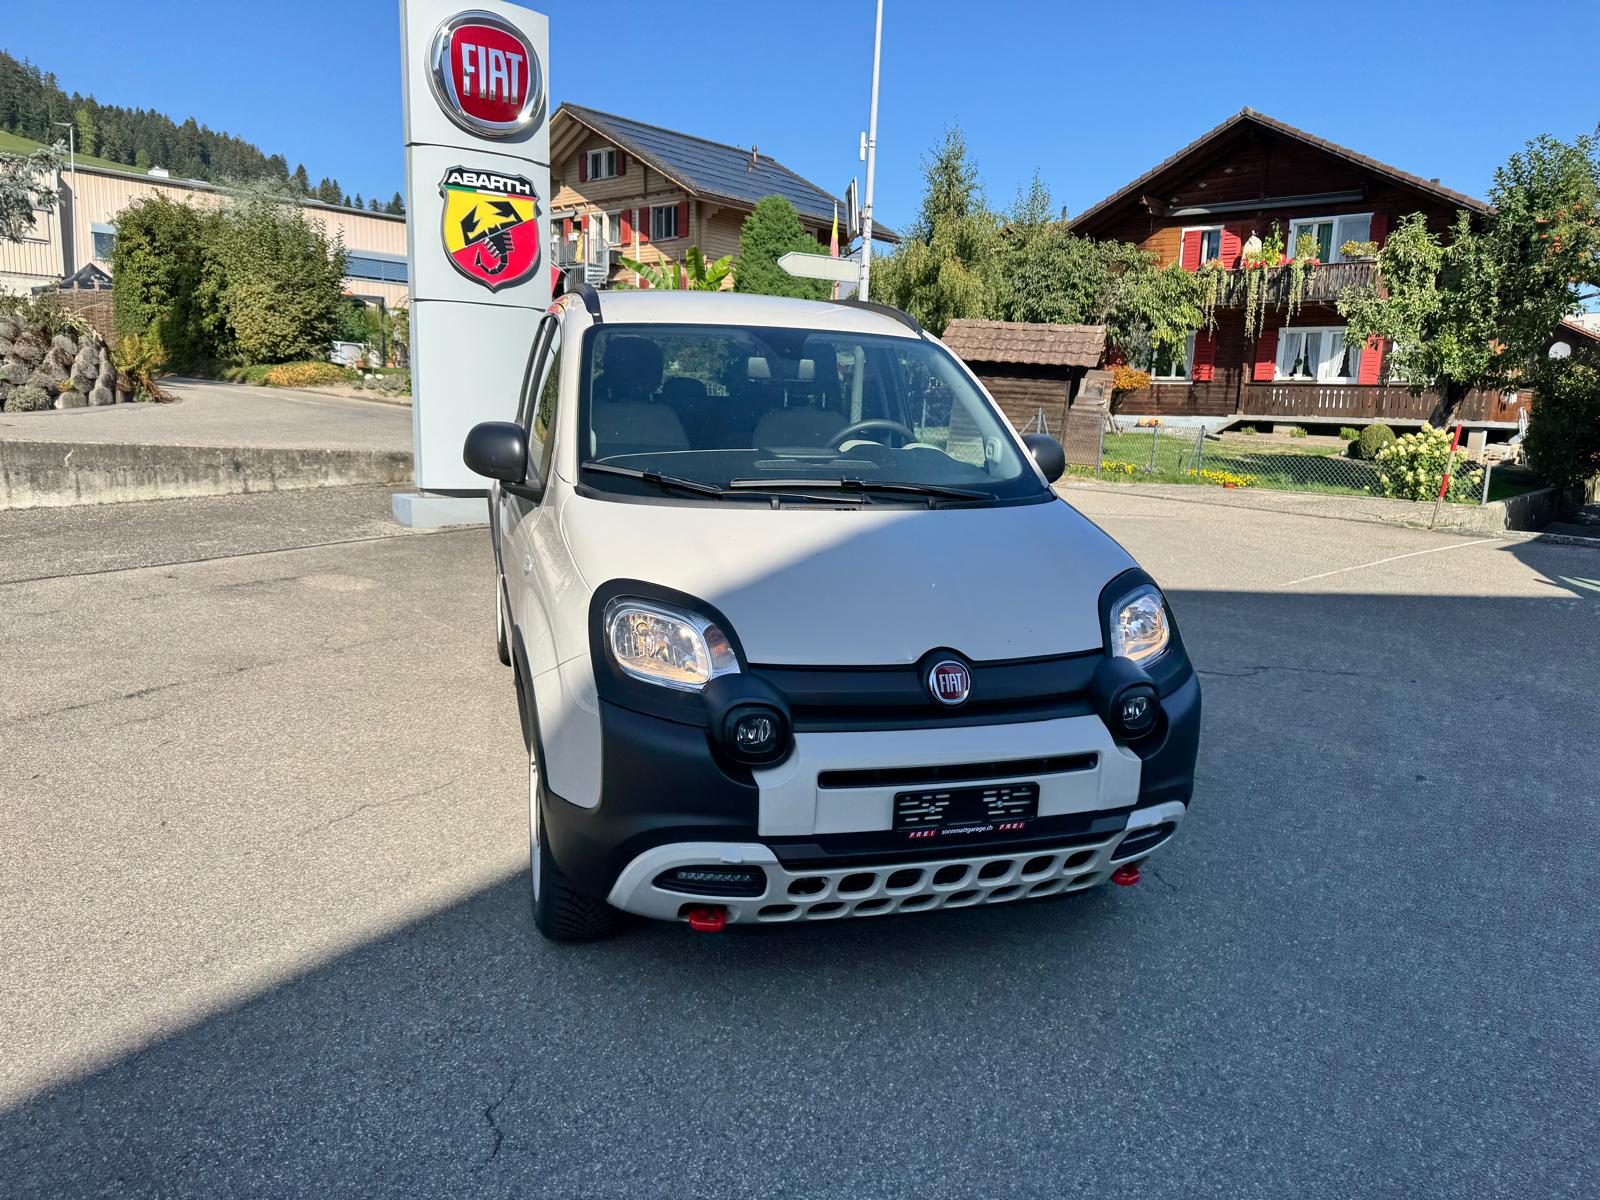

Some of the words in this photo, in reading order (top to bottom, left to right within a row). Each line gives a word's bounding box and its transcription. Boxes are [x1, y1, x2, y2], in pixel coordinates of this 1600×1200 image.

[461, 43, 522, 104] FIAT
[448, 172, 530, 194] ABARTH
[938, 672, 962, 693] FIAT
[941, 825, 993, 835] sonnmattgarage.ch
